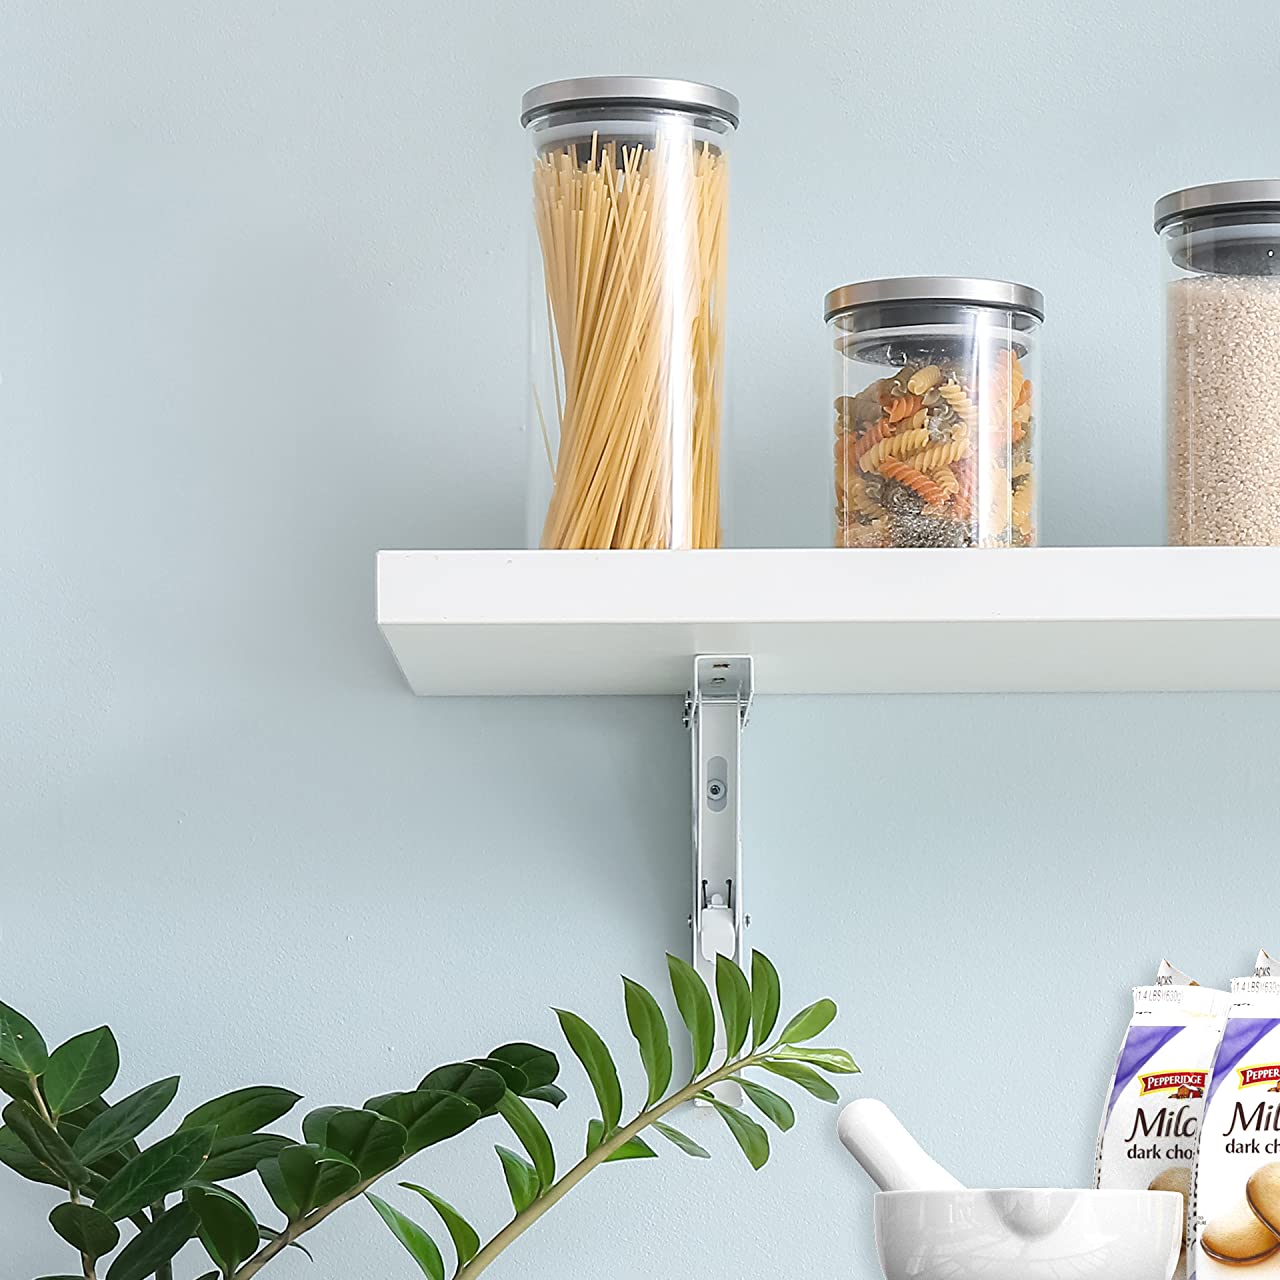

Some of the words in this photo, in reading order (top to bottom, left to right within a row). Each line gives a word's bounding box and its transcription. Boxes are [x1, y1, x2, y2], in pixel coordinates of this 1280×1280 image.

[1255, 967, 1271, 977] ACKS
[1147, 1074, 1202, 1088] PEPPERIDGE
[1126, 1143, 1162, 1160] dark
[1225, 1138, 1261, 1155] dark
